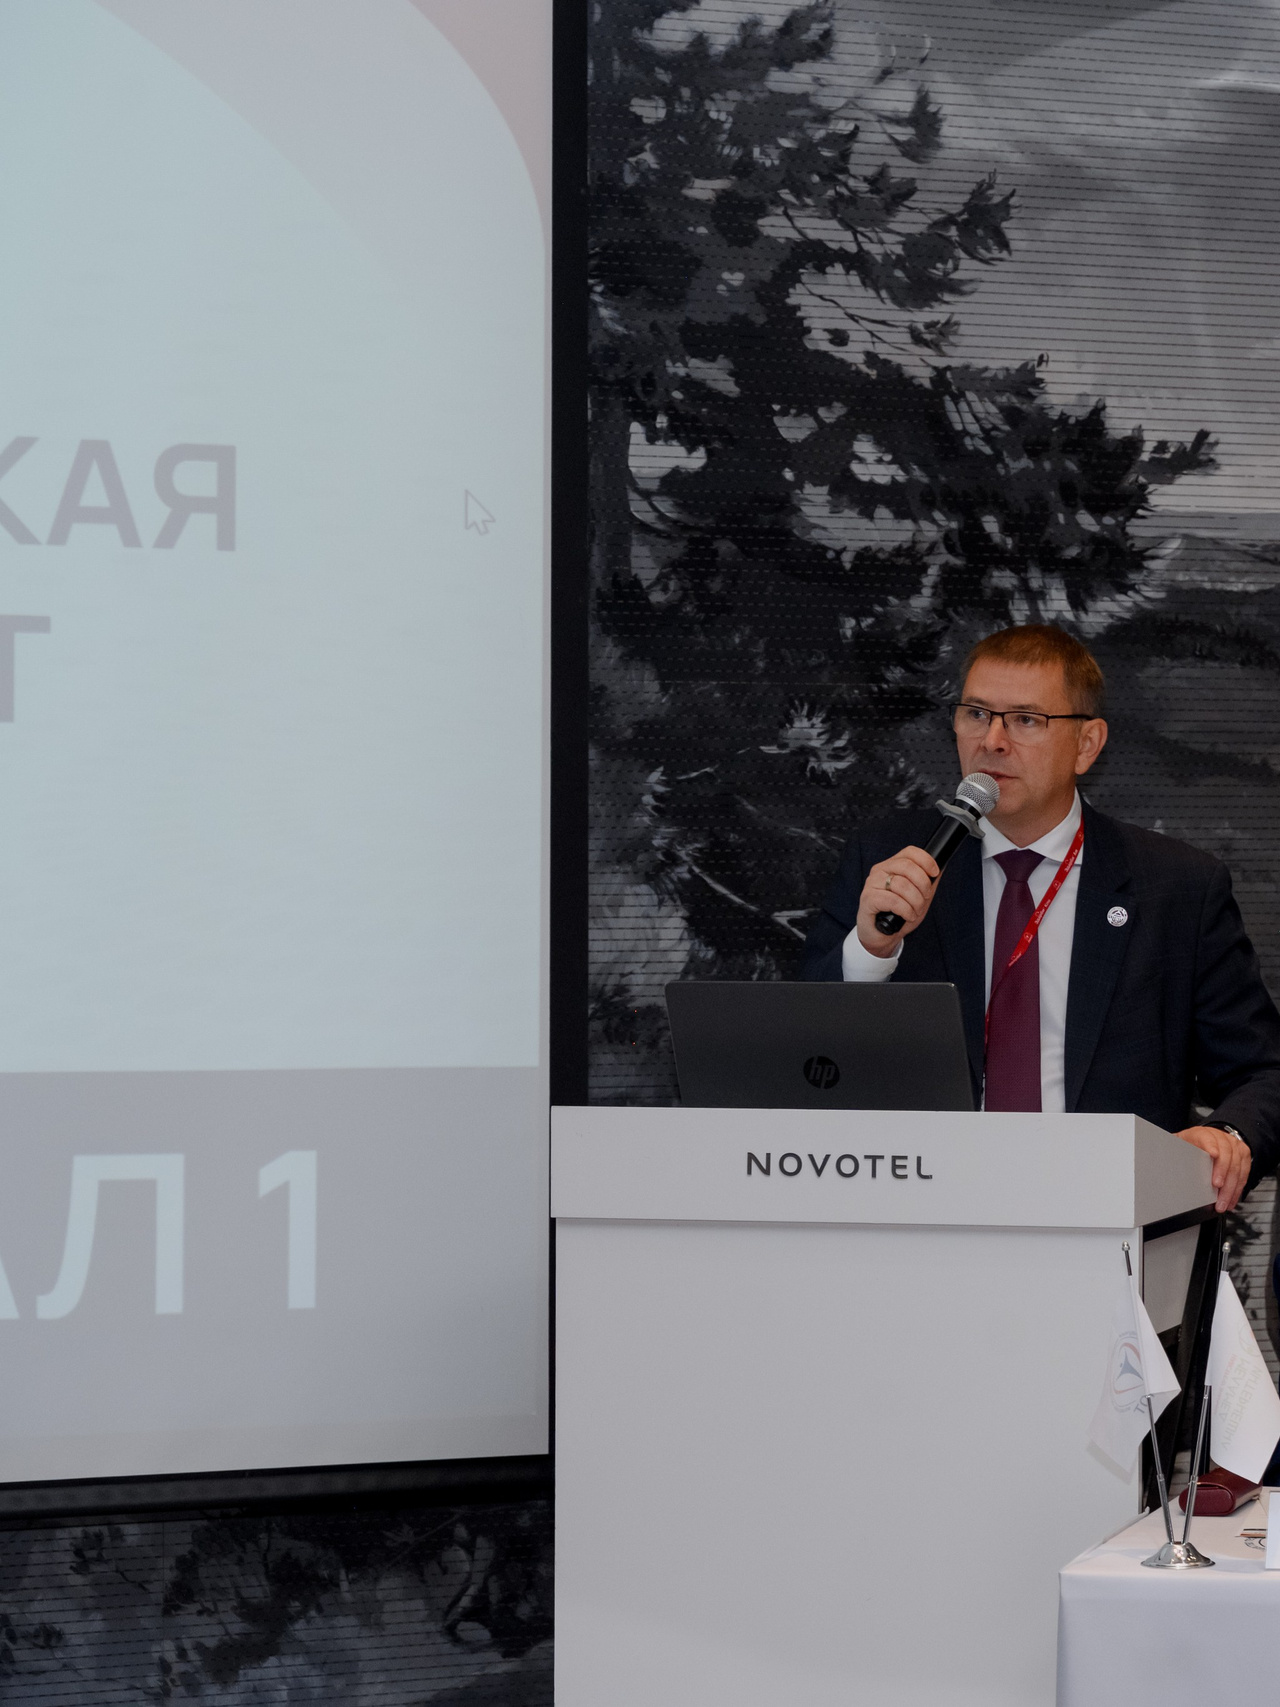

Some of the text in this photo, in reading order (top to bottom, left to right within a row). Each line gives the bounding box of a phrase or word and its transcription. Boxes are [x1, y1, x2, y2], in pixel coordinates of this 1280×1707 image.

[807, 1056, 837, 1089] hp
[747, 1152, 933, 1180] NOVOTEL
[0, 1150, 317, 1320] Л 1
